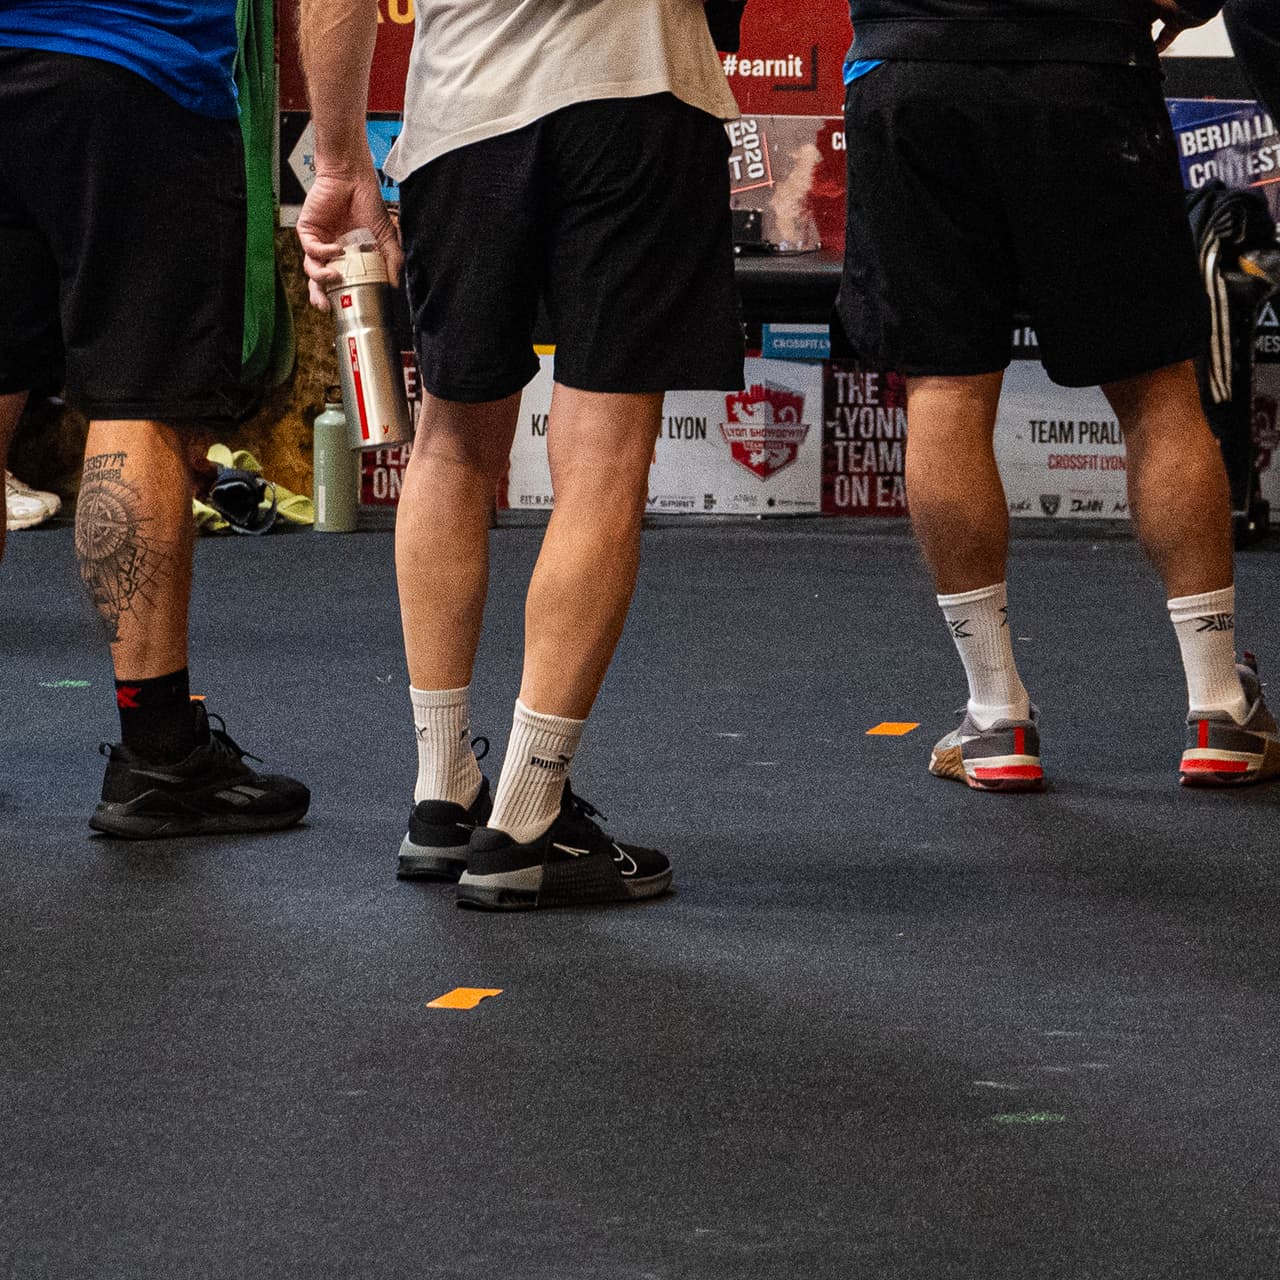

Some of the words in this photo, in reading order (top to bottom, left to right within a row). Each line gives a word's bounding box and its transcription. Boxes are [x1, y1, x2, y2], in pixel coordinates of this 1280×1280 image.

[722, 53, 803, 79] #earnit
[740, 119, 766, 180] 2020
[833, 371, 880, 407] THE
[667, 416, 707, 441] LYON
[1029, 419, 1076, 445] TEAM
[833, 441, 903, 473] TEAM
[833, 474, 870, 508] ON
